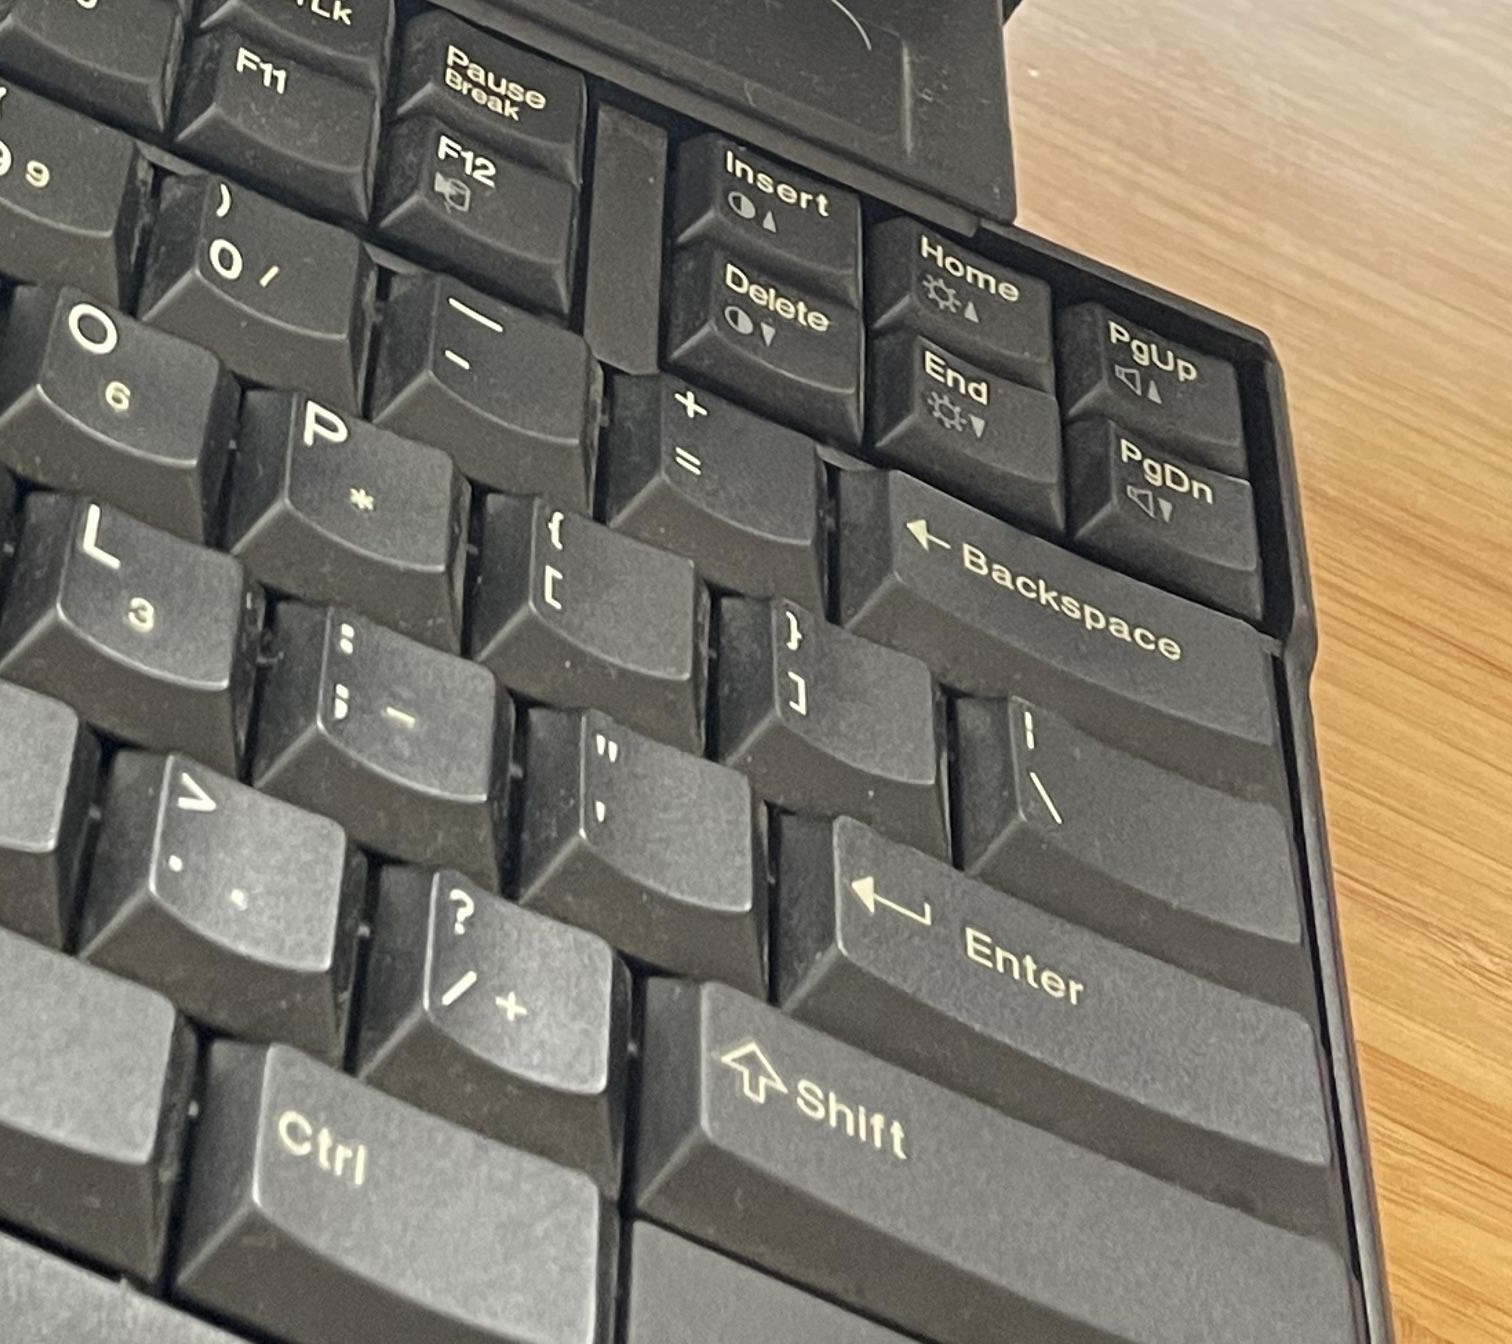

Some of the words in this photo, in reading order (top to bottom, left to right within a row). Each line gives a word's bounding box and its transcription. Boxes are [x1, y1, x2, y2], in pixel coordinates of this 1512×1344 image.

[236, 47, 287, 94] F11
[444, 67, 520, 121] Break
[446, 45, 547, 110] Pause
[25, 160, 50, 188] 9
[438, 134, 497, 188] F12
[724, 150, 830, 218] Insert
[216, 183, 231, 217] )
[209, 238, 243, 280] 0
[920, 236, 1020, 302] Home
[724, 263, 830, 333] Delete
[68, 303, 118, 355] O
[1109, 321, 1198, 384] PgUp
[105, 381, 131, 412] 6
[925, 350, 988, 410] End
[303, 400, 348, 447] P
[674, 391, 708, 418] +
[675, 447, 701, 475] =
[1120, 437, 1215, 505] PgDn
[82, 504, 121, 570] L
[548, 511, 564, 550] {
[544, 564, 563, 610] [
[962, 543, 1181, 661] Backspace
[128, 597, 155, 633] 3
[785, 611, 802, 651] }
[339, 623, 355, 655] :
[787, 671, 807, 716] ]
[177, 772, 217, 812] >
[449, 888, 475, 935] ?
[965, 927, 1084, 1005] Enter
[796, 1079, 907, 1159] Shift
[277, 1110, 367, 1186] Ctrl
